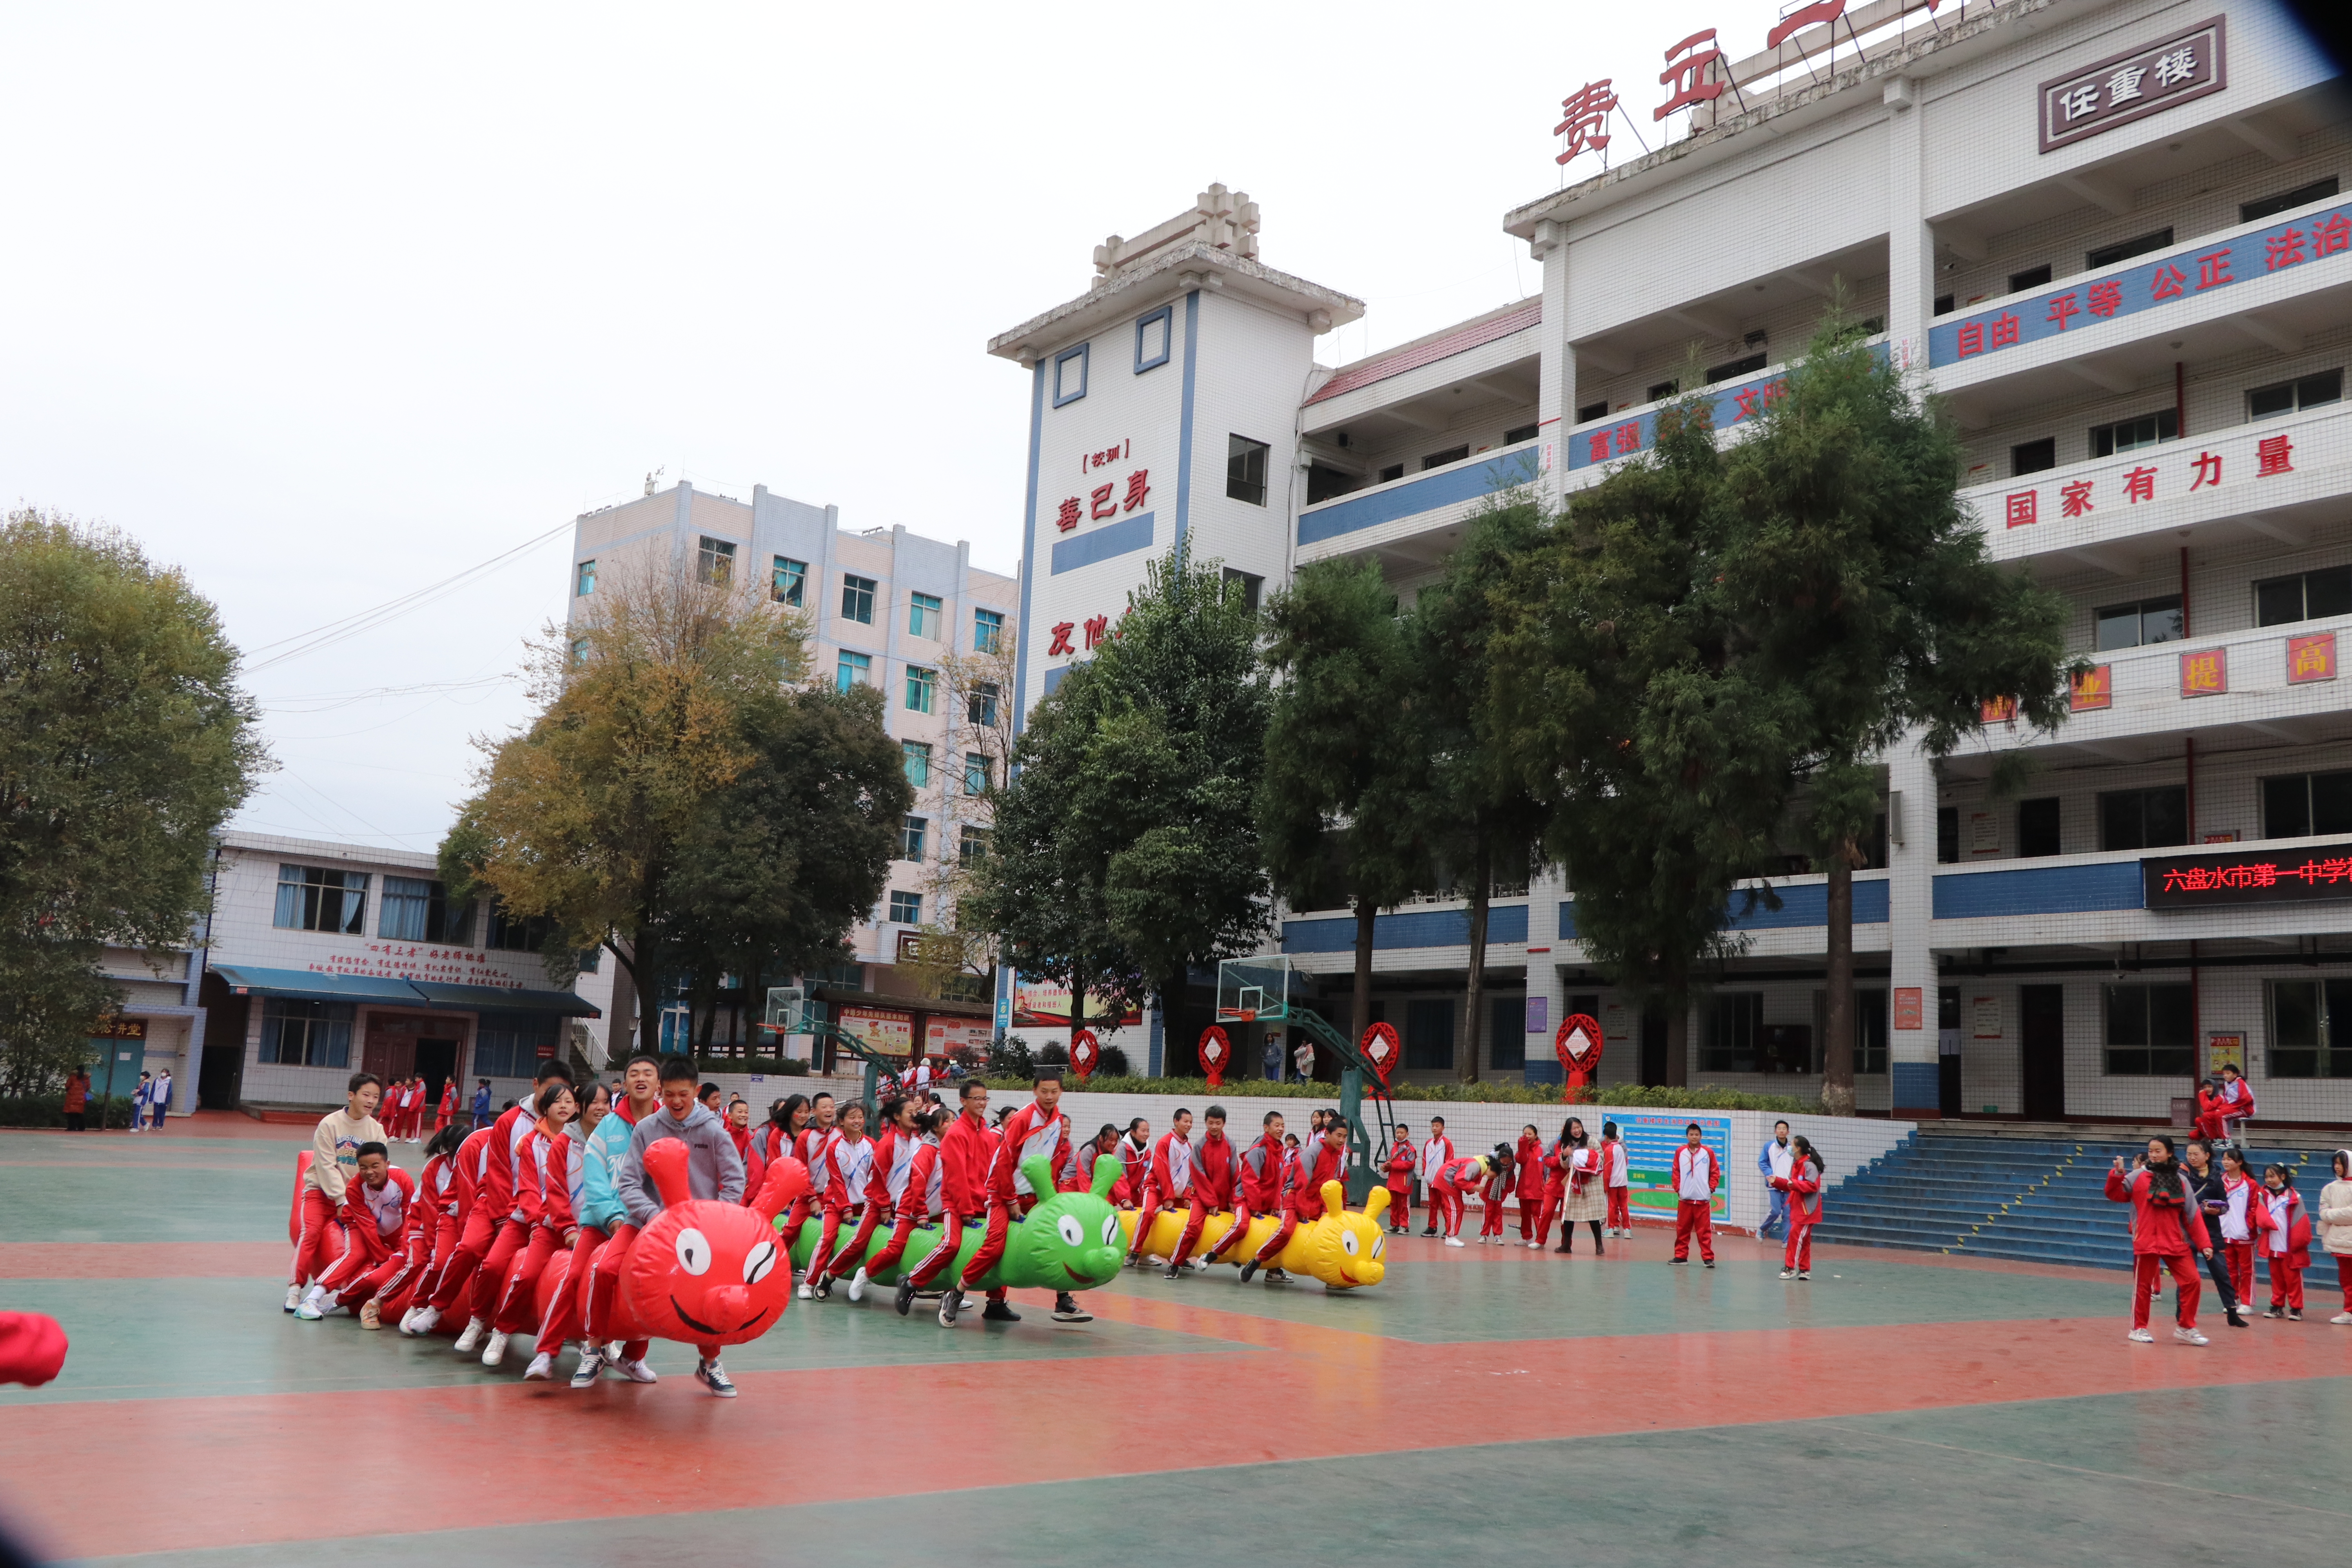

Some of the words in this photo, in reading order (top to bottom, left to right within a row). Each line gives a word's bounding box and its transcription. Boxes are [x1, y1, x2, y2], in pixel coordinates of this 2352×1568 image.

[2059, 46, 2198, 122] 任重楼
[1957, 312, 2019, 358] 自由
[2046, 279, 2123, 330] 平等
[2149, 248, 2234, 301] 公正
[2265, 213, 2352, 270] 法治
[1589, 421, 1641, 463] 富强
[1056, 468, 1150, 532] 善己身
[2006, 434, 2294, 529] 国家有力量
[1048, 606, 1131, 655] 友他
[2163, 857, 2352, 892] 六盘水市第一中学
